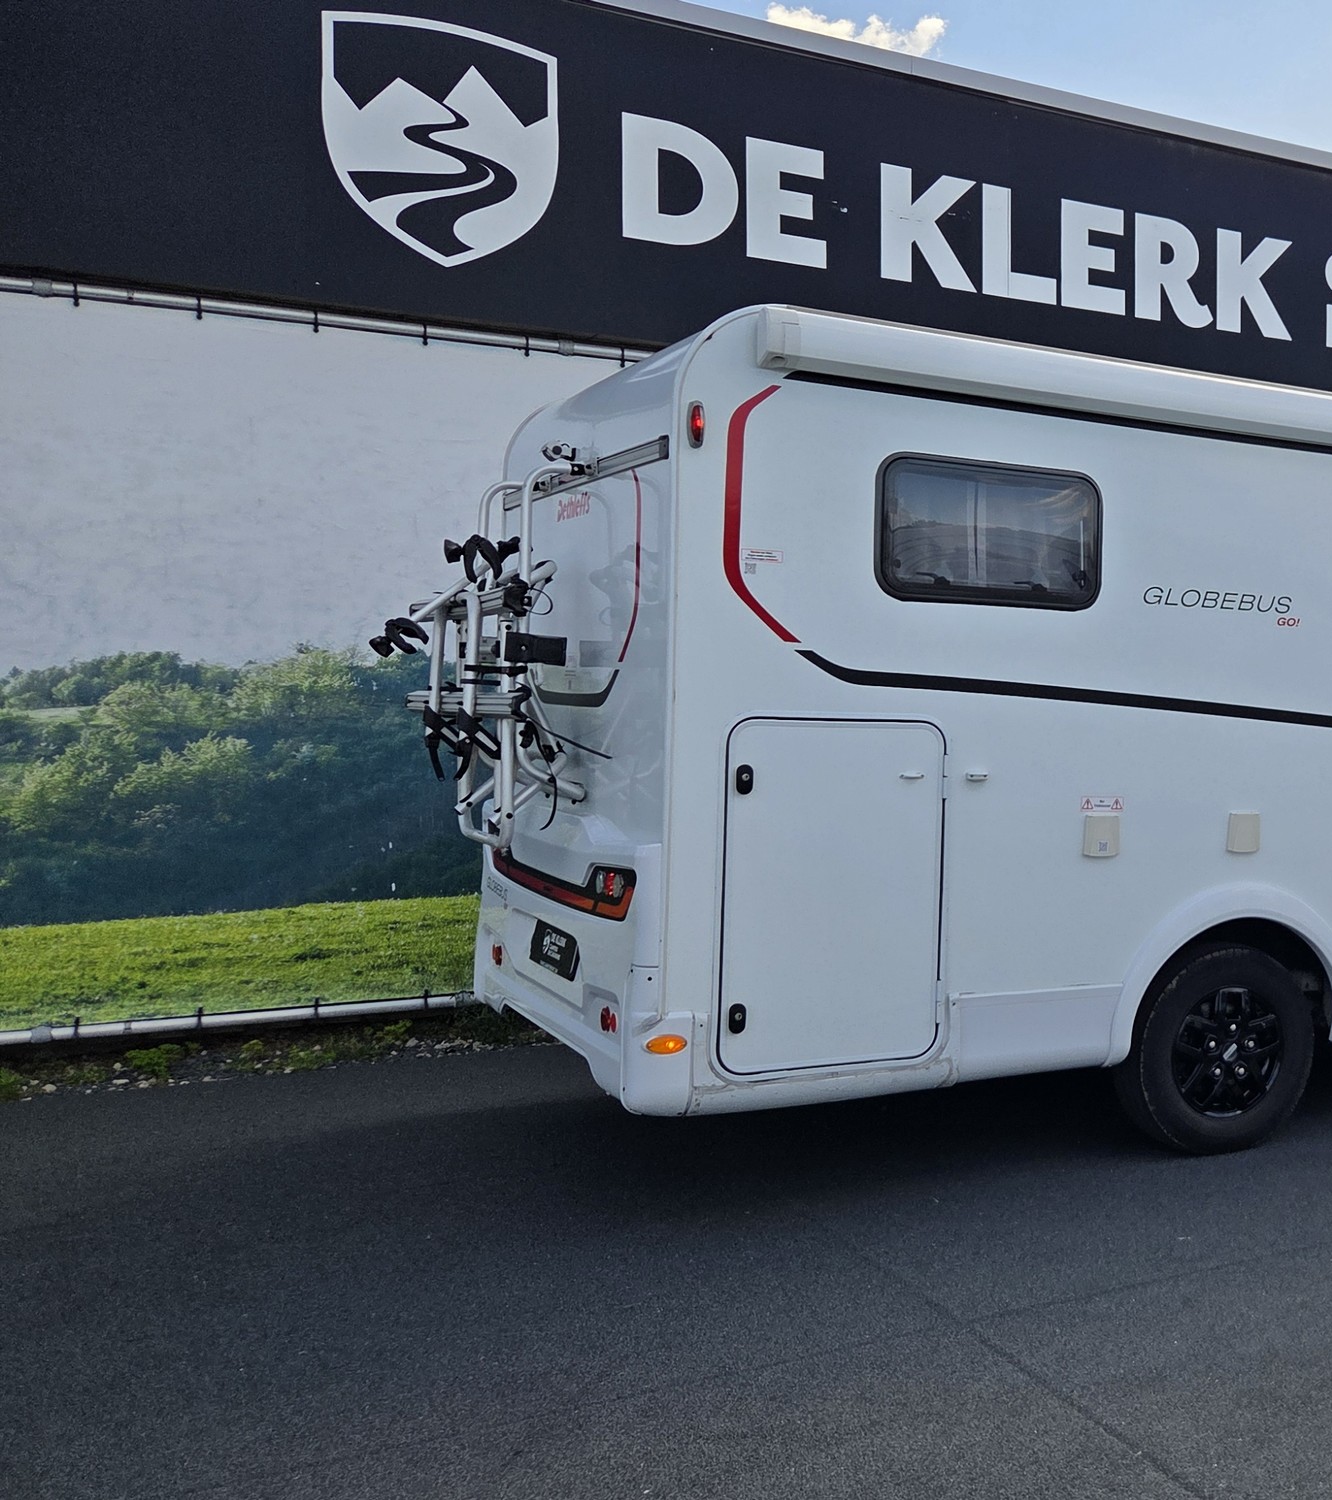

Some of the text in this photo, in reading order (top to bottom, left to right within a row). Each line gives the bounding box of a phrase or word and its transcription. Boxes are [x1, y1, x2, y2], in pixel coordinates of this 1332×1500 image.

[621, 111, 1293, 342] DE KLERK
[1143, 586, 1293, 614] GLOBEBUS
[1276, 617, 1301, 627] GO!
